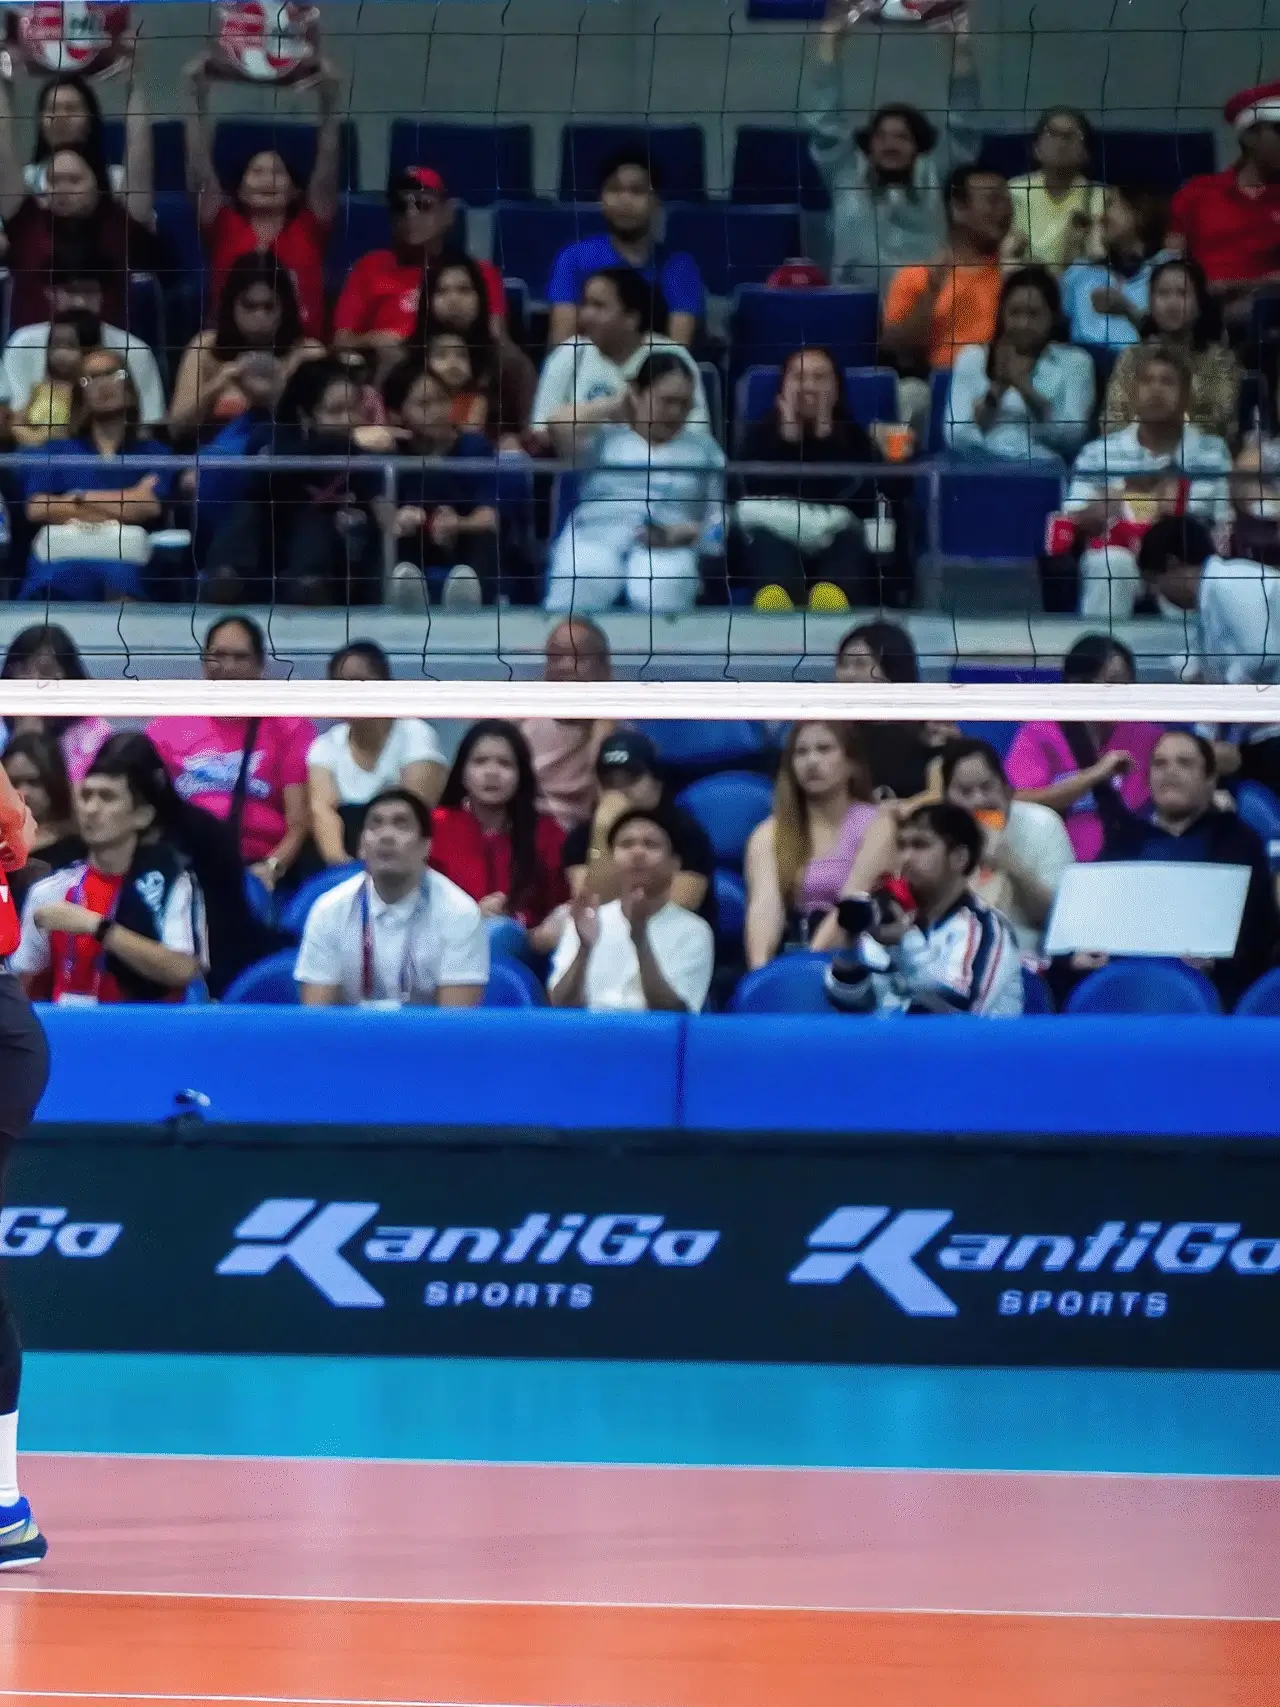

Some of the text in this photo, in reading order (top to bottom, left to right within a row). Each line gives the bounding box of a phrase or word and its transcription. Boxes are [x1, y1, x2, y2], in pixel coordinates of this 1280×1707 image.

[214, 1198, 721, 1308] KantiGo
[424, 1281, 594, 1309] SPORTS
[997, 1289, 1170, 1317] SPORTS
